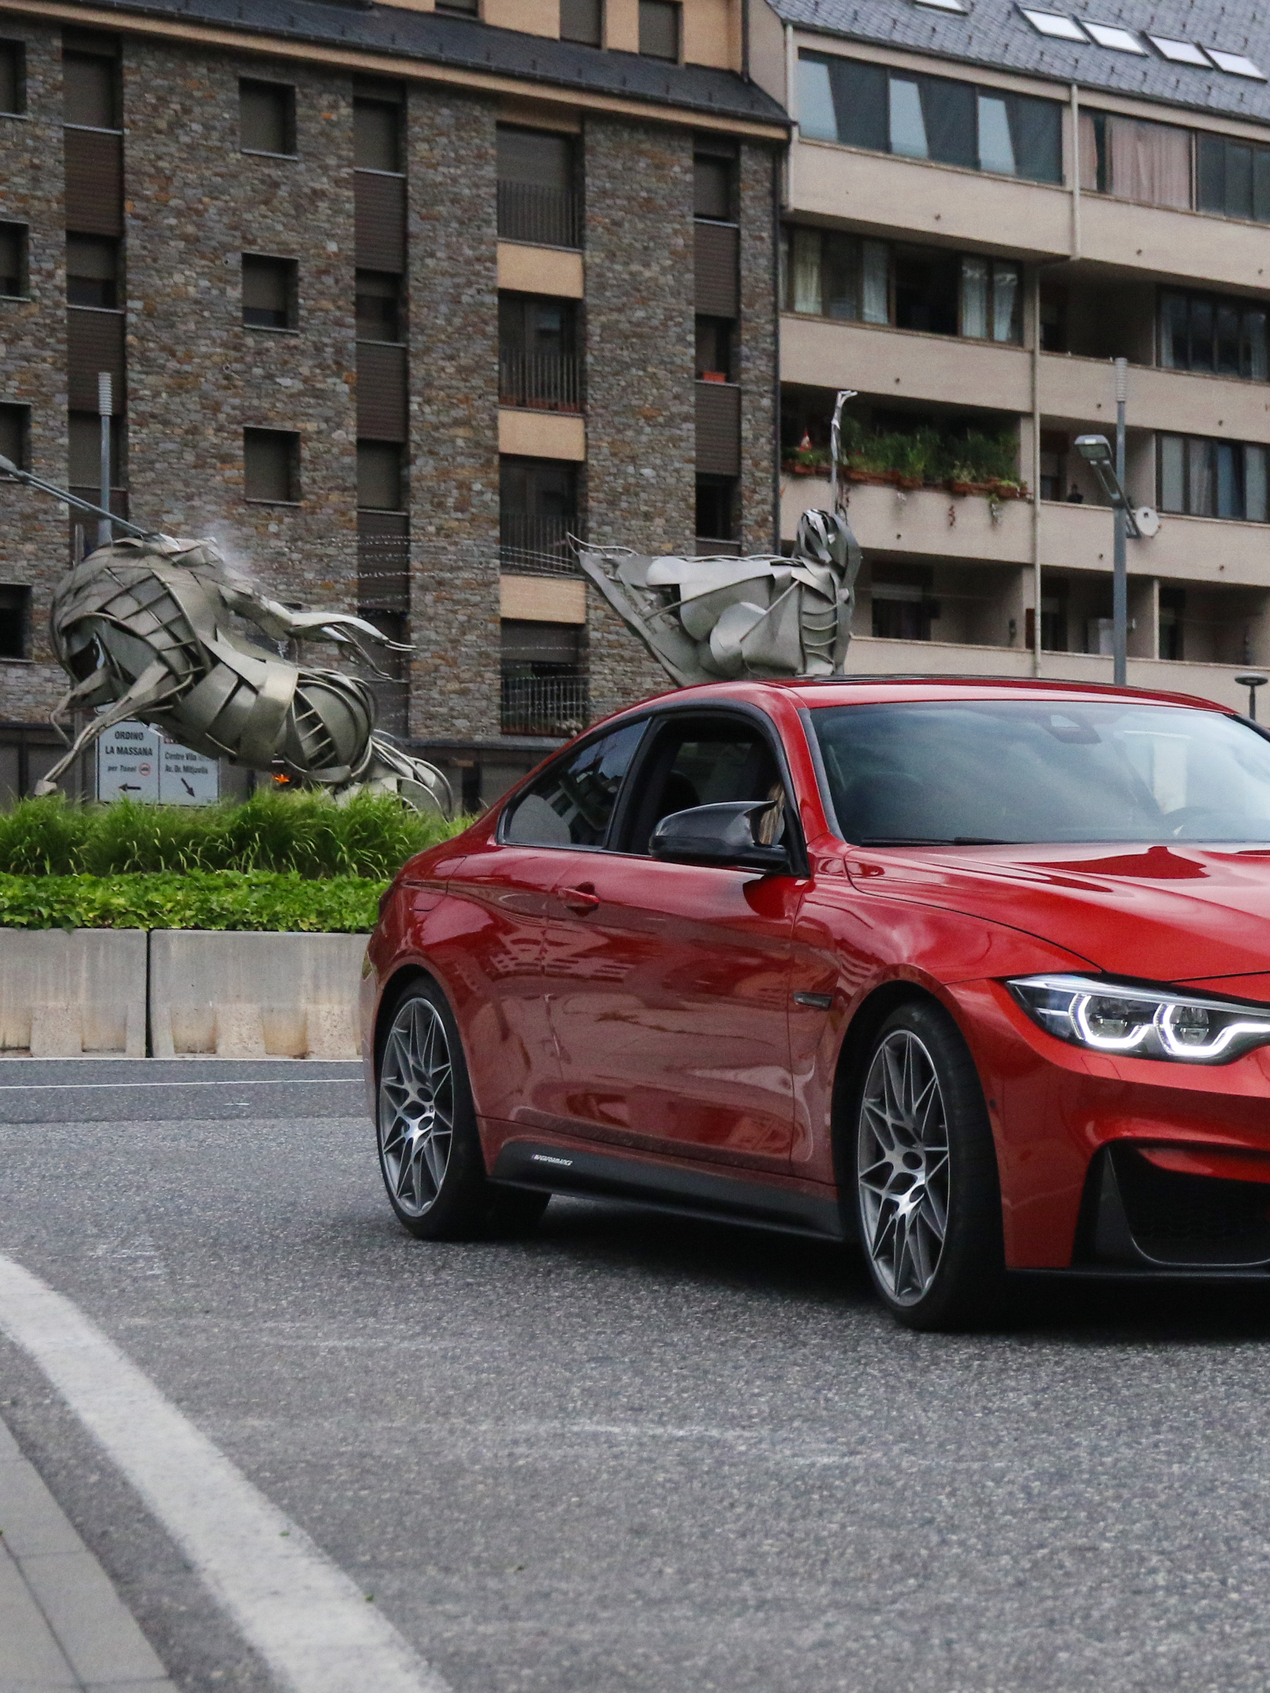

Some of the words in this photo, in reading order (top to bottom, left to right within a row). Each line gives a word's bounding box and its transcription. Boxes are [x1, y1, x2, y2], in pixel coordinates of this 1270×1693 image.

[115, 731, 144, 741] ORDINO
[105, 745, 115, 755] LA
[116, 746, 153, 756] MASSANA
